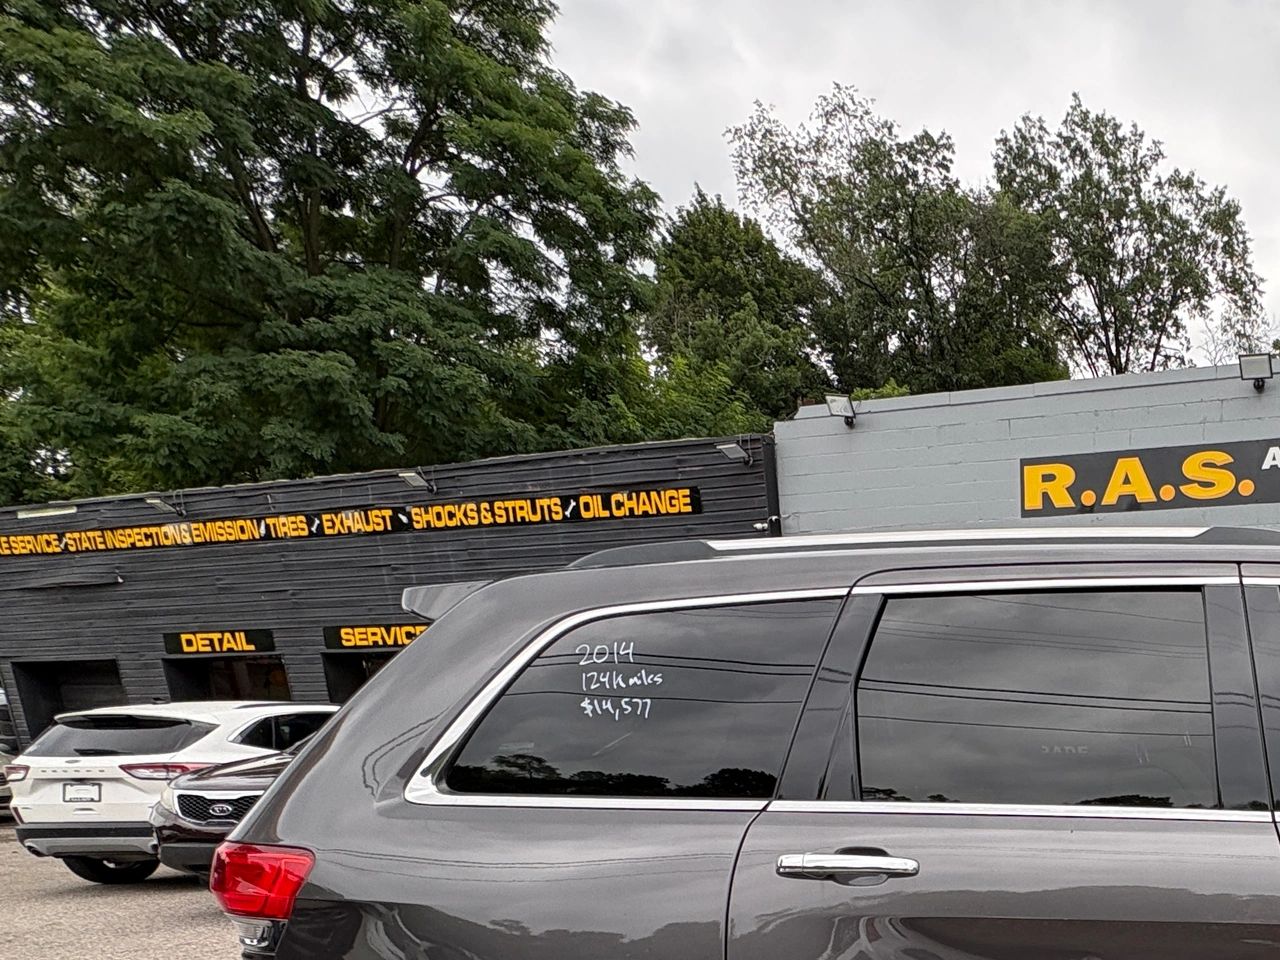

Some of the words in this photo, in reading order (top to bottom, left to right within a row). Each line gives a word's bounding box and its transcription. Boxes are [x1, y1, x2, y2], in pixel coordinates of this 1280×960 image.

[1022, 450, 1256, 510] R.A.S.
[10, 533, 62, 555] SERVICE
[65, 531, 105, 551] STATE
[104, 525, 182, 549] INSPECTION
[182, 522, 192, 545] &
[191, 519, 260, 543] EMISSION
[265, 515, 309, 538] TIRES
[321, 509, 393, 535] EXHAUST
[411, 503, 479, 529] SHOCKS
[480, 502, 494, 524] &
[493, 497, 563, 523] STRUTS
[579, 494, 610, 519] OIL
[610, 488, 692, 517] CHANGE
[180, 631, 256, 653] DETAIL
[576, 641, 634, 665] 2014
[629, 668, 663, 686] miles
[580, 697, 652, 721] $14,577
